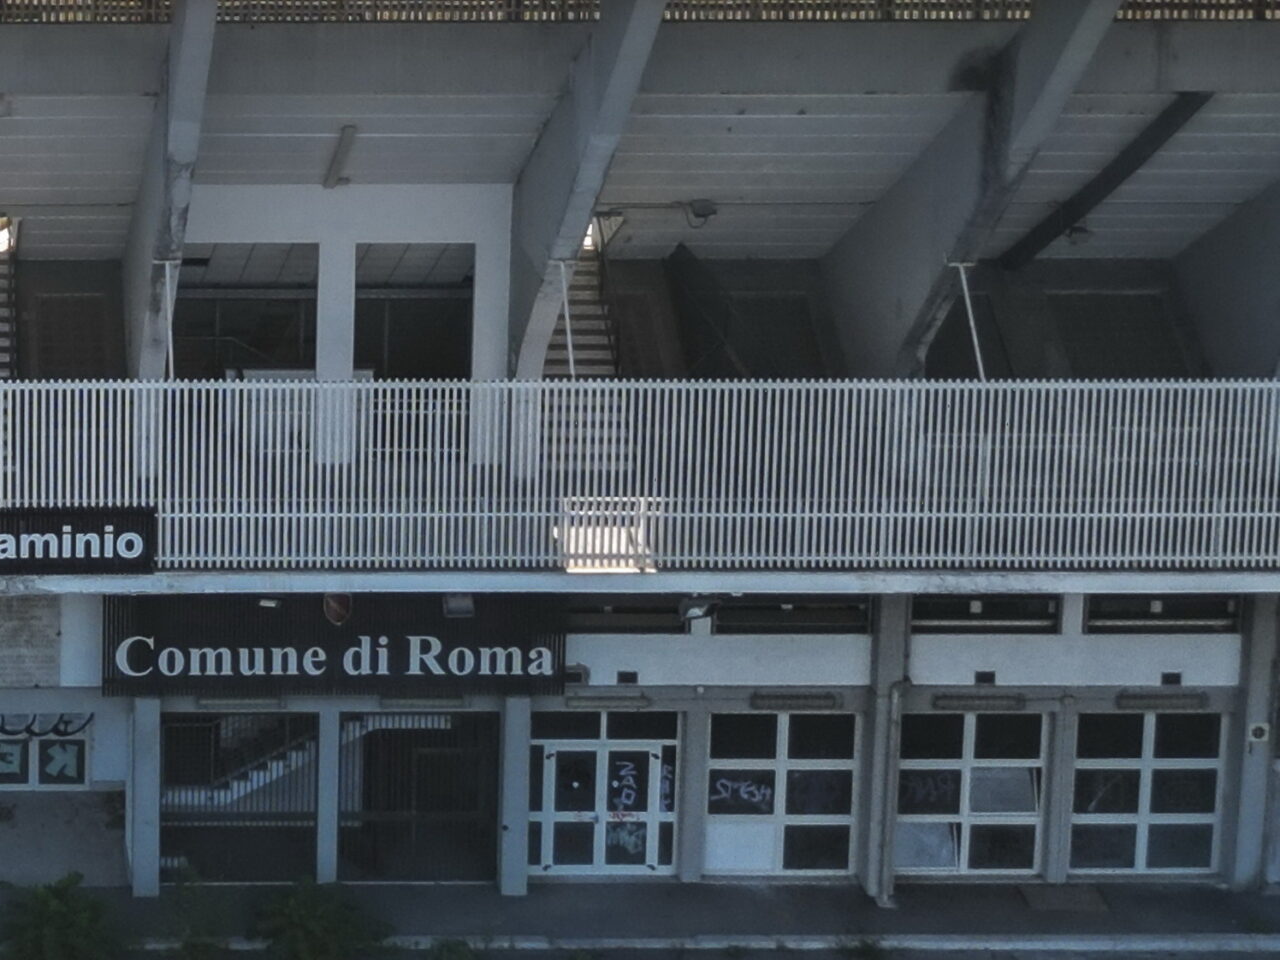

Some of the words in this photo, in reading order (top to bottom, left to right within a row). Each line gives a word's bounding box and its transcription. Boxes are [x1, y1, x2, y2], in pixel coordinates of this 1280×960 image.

[114, 635, 327, 677] Comune
[342, 635, 391, 676] di
[404, 635, 554, 677] Roma
